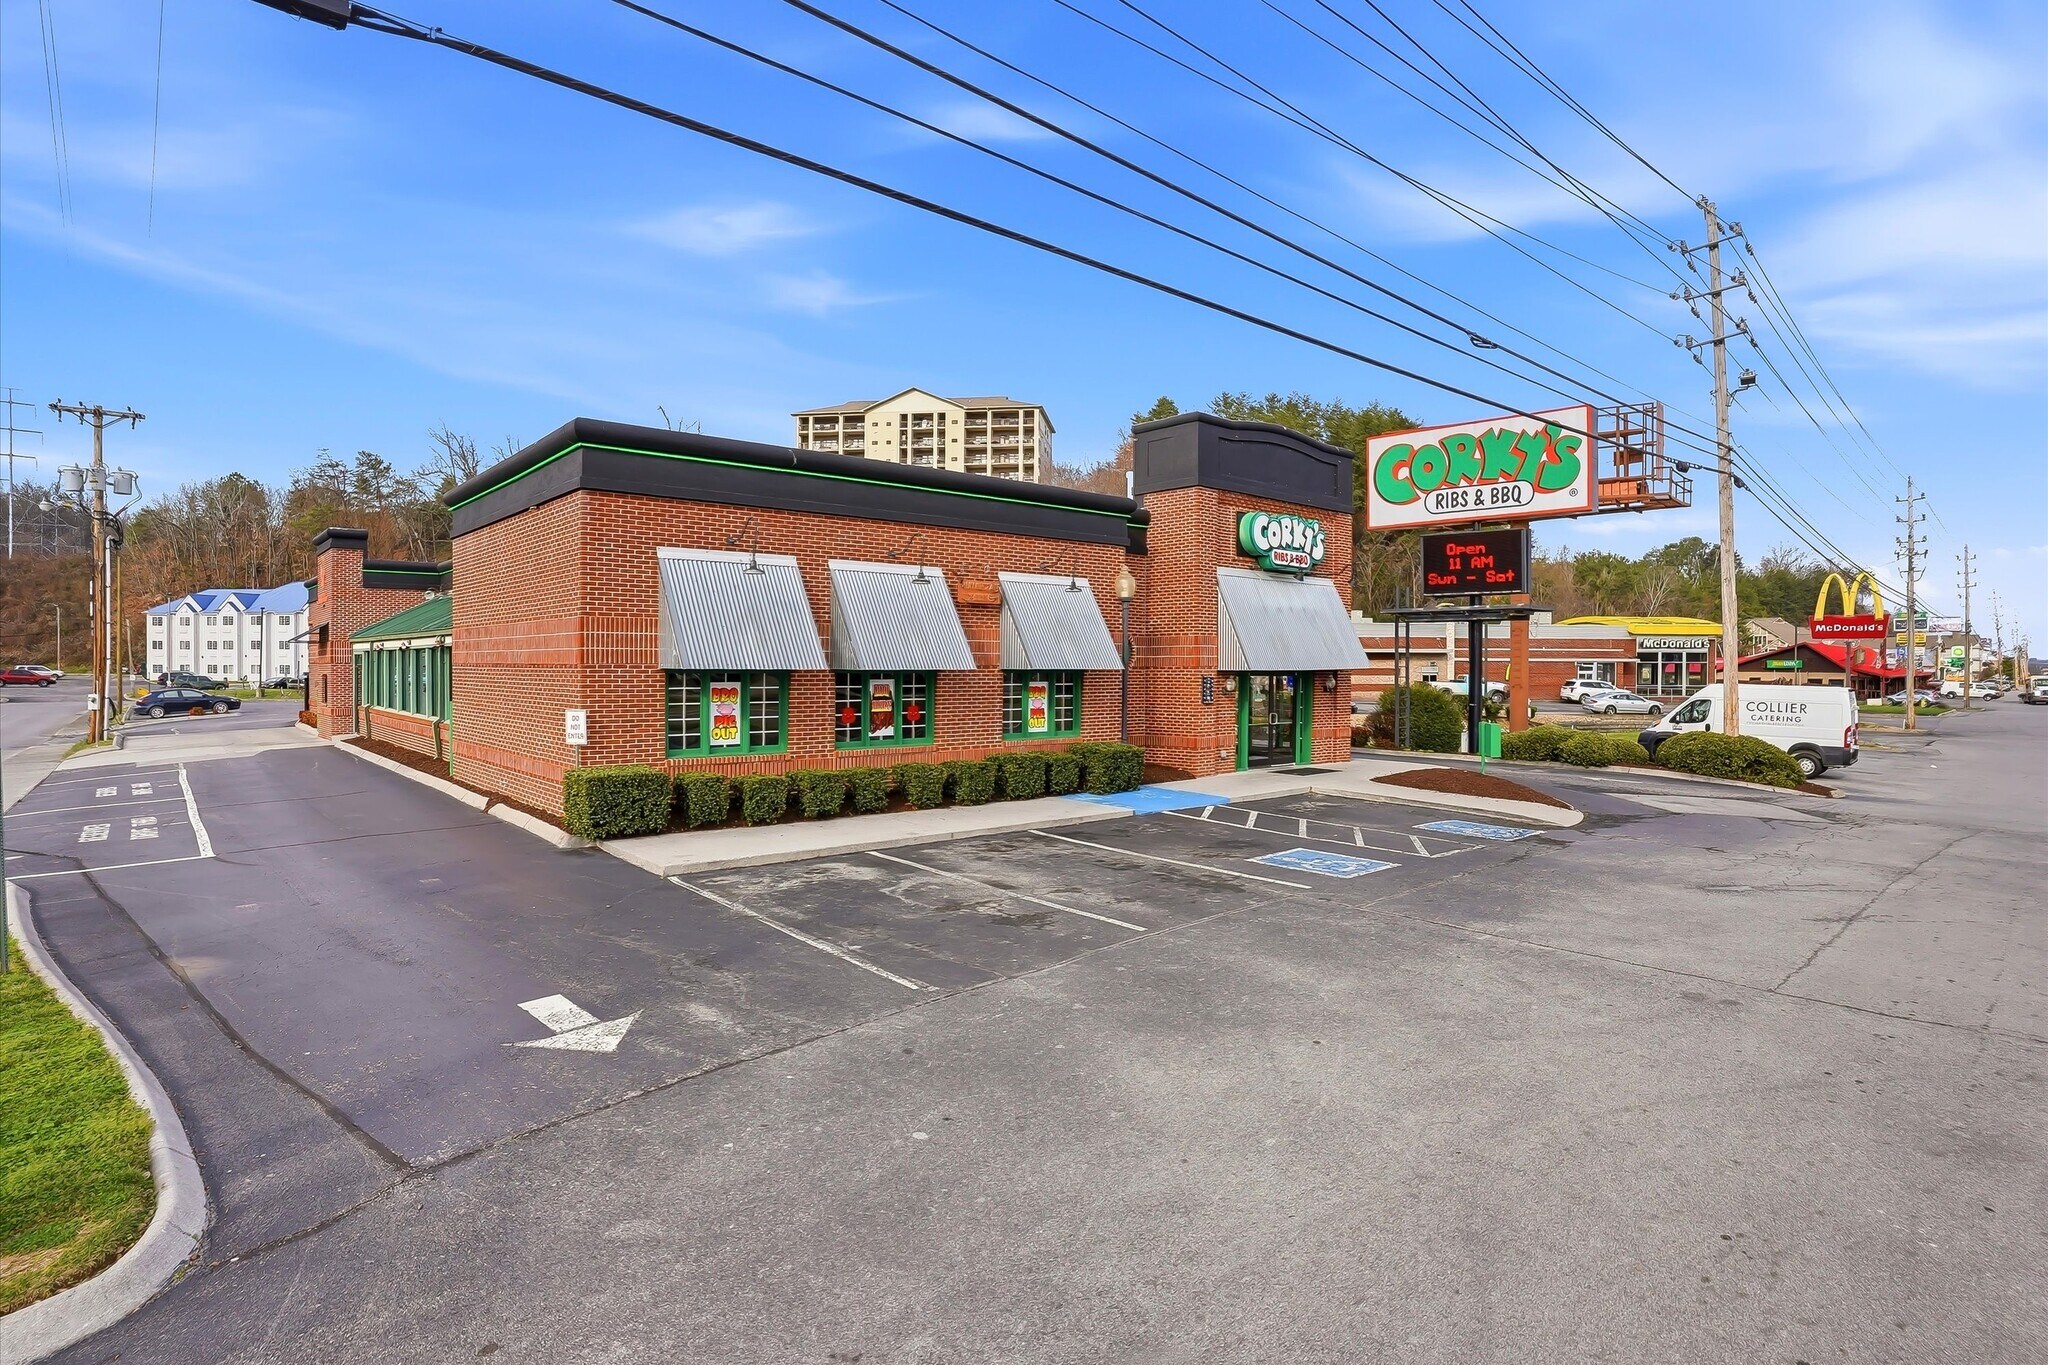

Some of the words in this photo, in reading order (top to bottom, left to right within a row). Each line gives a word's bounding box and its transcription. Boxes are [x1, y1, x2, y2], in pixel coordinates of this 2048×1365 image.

[1374, 421, 1582, 504] CORKY'S
[1435, 489, 1468, 510] RIBS
[1474, 488, 1485, 506] &
[1490, 485, 1522, 505] BBQ
[1253, 515, 1325, 561] CORKY'S
[1446, 543, 1486, 556] Open
[1273, 551, 1289, 563] RIBS
[1449, 557, 1462, 570] 11
[1470, 555, 1494, 569] AM
[1427, 573, 1457, 585] Sun
[1486, 569, 1515, 583] Sat
[1815, 623, 1884, 632] McDonald's
[1642, 638, 1710, 648] McDonald's
[1746, 701, 1807, 714] COLLIER
[1750, 714, 1802, 723] CATERING
[711, 727, 738, 740] OUT
